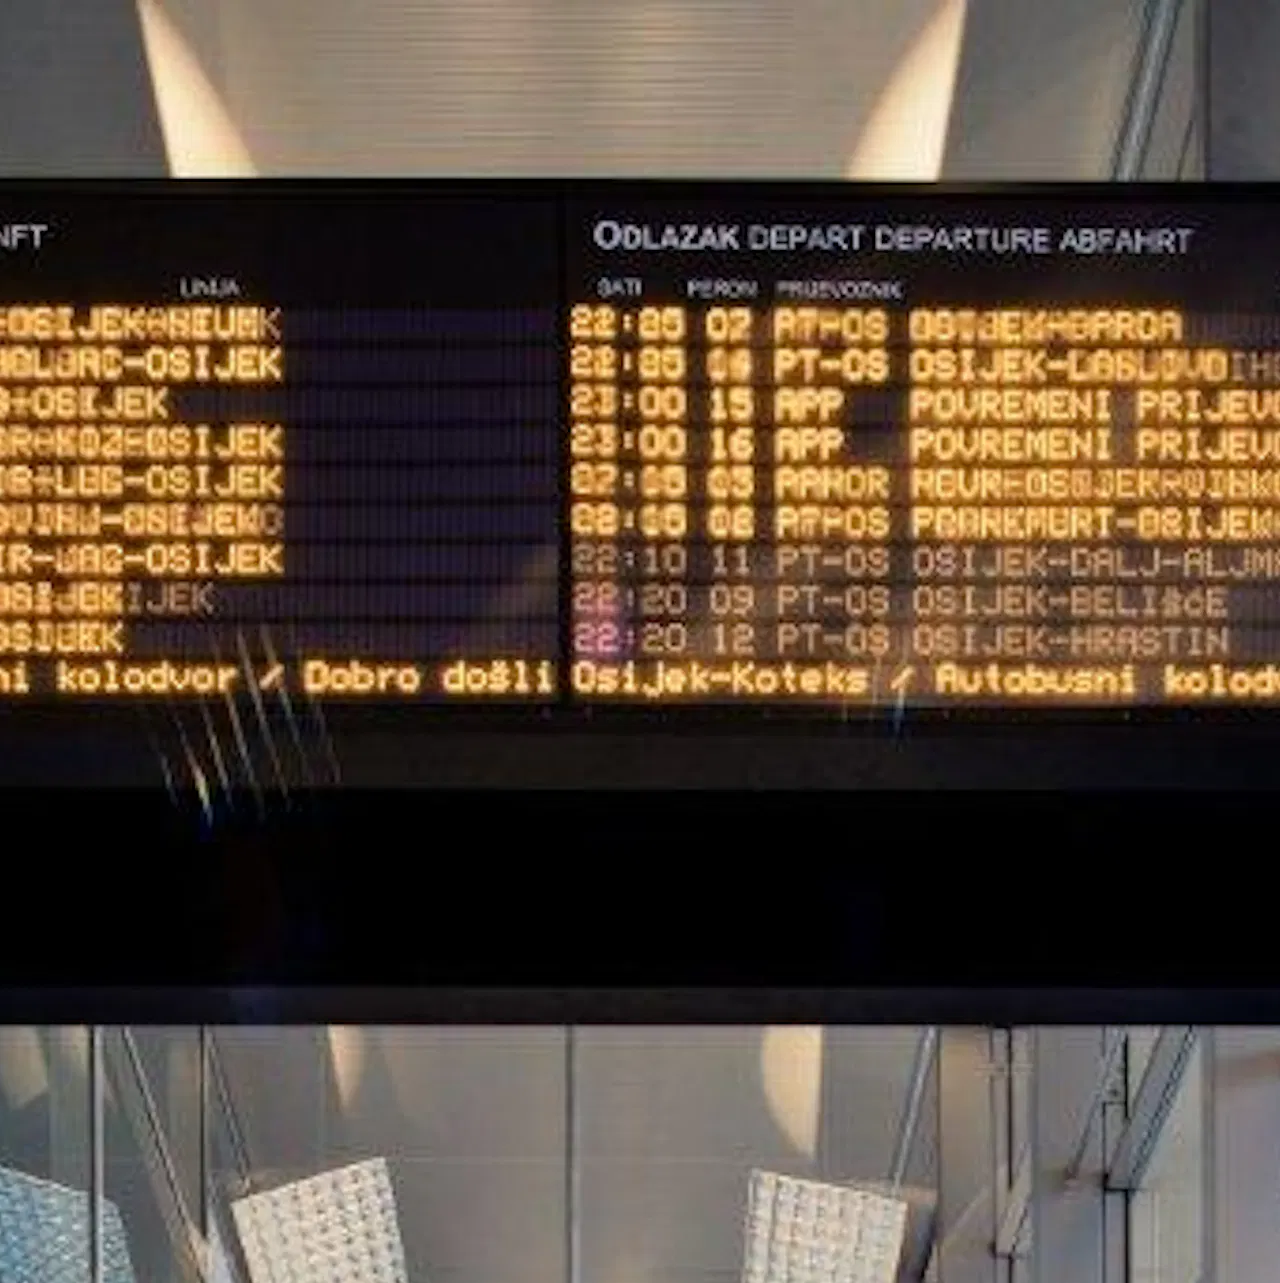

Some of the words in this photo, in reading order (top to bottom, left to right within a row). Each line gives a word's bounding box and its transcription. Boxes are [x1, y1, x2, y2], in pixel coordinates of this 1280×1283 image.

[593, 220, 739, 251] ODLAZAK
[748, 225, 865, 251] DEPART
[875, 226, 1051, 252] DEPARTURE
[1060, 228, 1193, 254] ABFAHRT
[909, 387, 1111, 422] POVREMENI
[909, 426, 1111, 462] POVREMENI
[705, 546, 755, 579] 11
[773, 546, 890, 579] PT-OS
[705, 585, 755, 618] 09
[773, 585, 890, 618] PT-OS
[572, 623, 687, 656] 22:20
[705, 623, 755, 656] 12
[773, 623, 890, 656] PT-OS
[56, 660, 240, 694] kolodvor
[303, 661, 420, 694] Dobro
[441, 660, 555, 694] došli
[571, 662, 869, 699] Osijek-Koteks
[935, 662, 1135, 697] Autobusni
